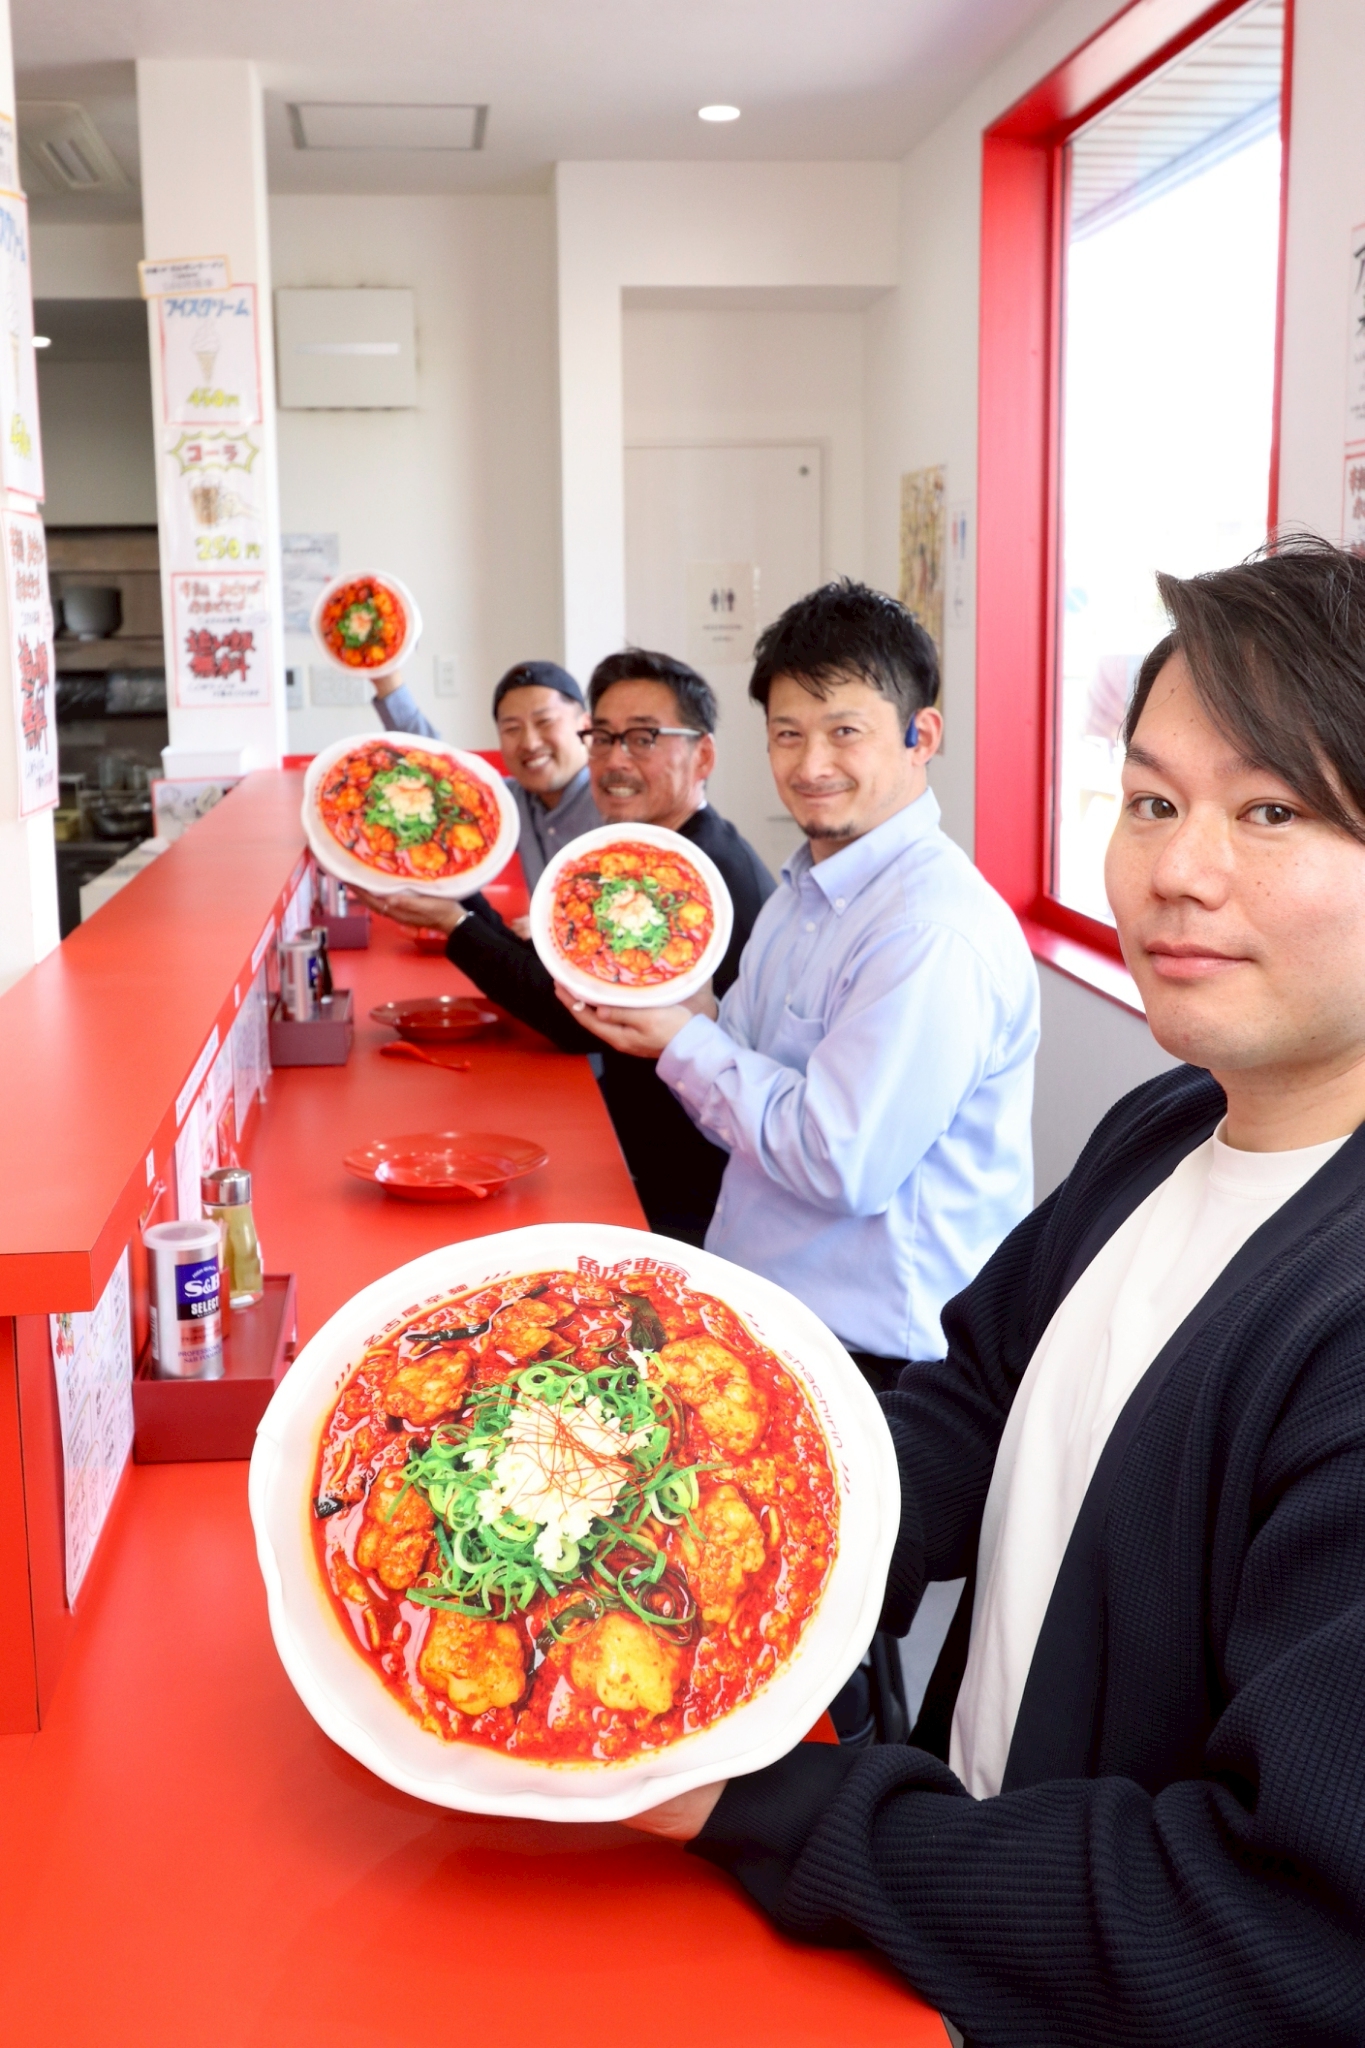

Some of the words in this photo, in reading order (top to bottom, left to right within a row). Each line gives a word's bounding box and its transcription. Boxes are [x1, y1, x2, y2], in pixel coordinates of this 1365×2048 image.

[165, 298, 249, 318] アイスクリーム
[186, 445, 239, 463] コーラ
[782, 1349, 844, 1449] shachirin
